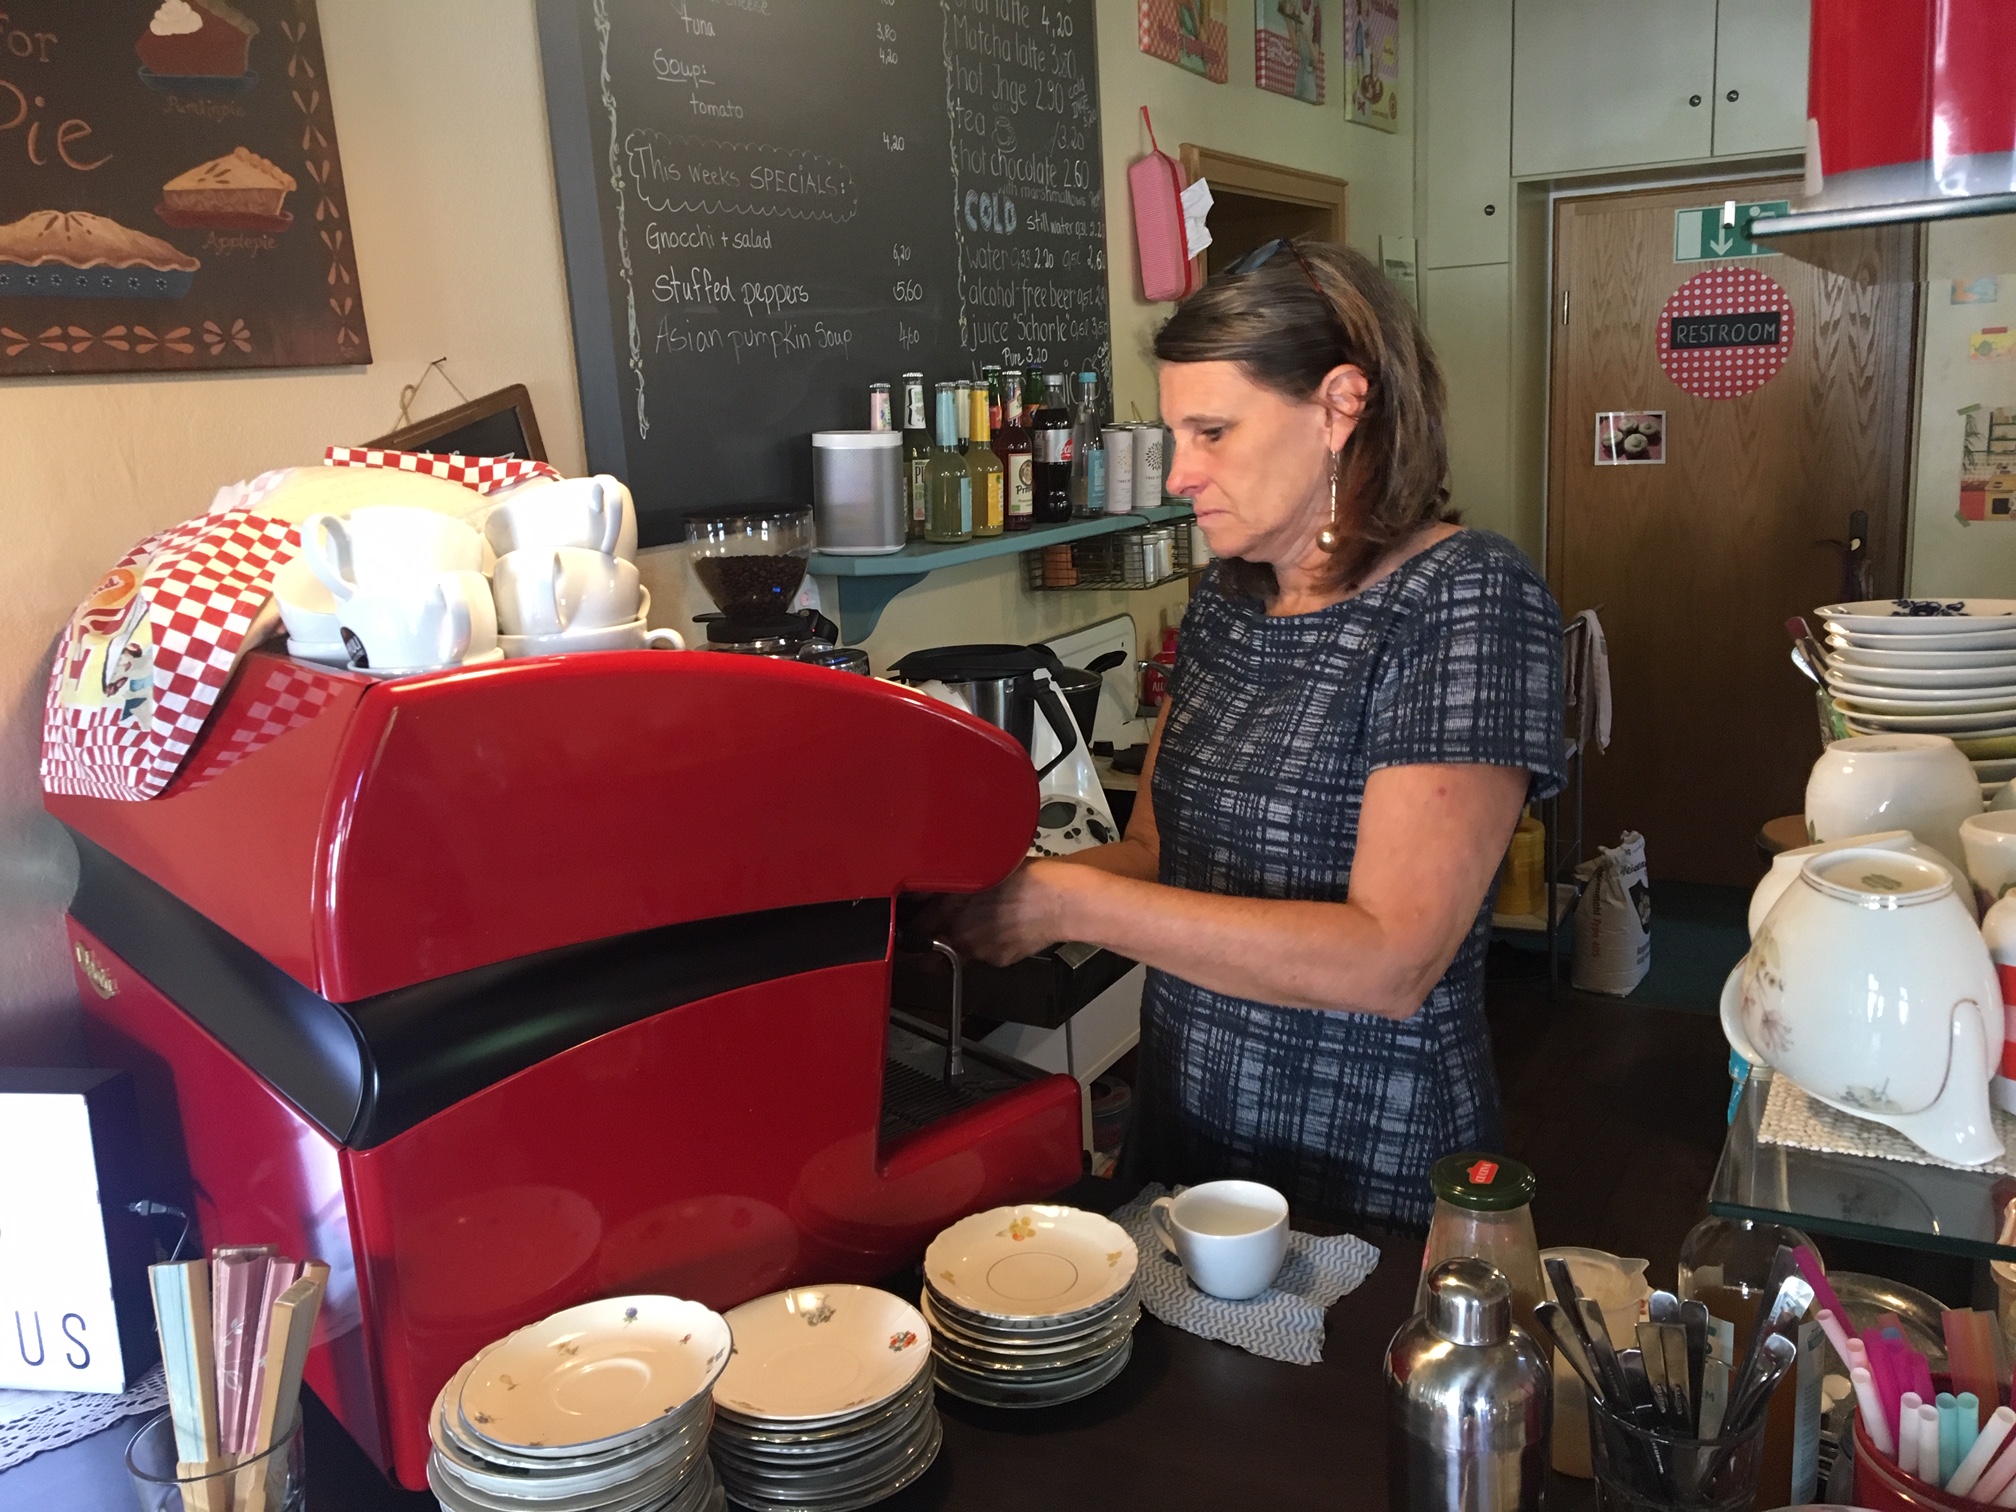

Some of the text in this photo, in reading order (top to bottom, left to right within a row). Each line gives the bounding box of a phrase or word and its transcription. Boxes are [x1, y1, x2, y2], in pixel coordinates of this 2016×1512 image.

[681, 3, 716, 37] tuna
[953, 14, 1011, 62] Matcha
[1015, 31, 1046, 72] latte
[653, 48, 707, 88] Soup:
[956, 54, 983, 96] hot
[690, 92, 744, 119] tomato
[956, 97, 985, 136] tea
[634, 143, 681, 183] This
[960, 139, 986, 176] hot
[991, 149, 1058, 188] chocolate
[964, 189, 1018, 236] COLD
[1020, 186, 1088, 208] marshmallows
[646, 222, 772, 254] Gnocchi + salad
[652, 266, 736, 303] Stuffed
[741, 281, 809, 317] peppers
[1049, 280, 1076, 310] beer
[655, 314, 724, 354] Asian
[815, 321, 853, 360] Soup
[970, 313, 1009, 352] juice
[1676, 322, 1777, 344] RESTROOM
[1002, 346, 1025, 367] Pure
